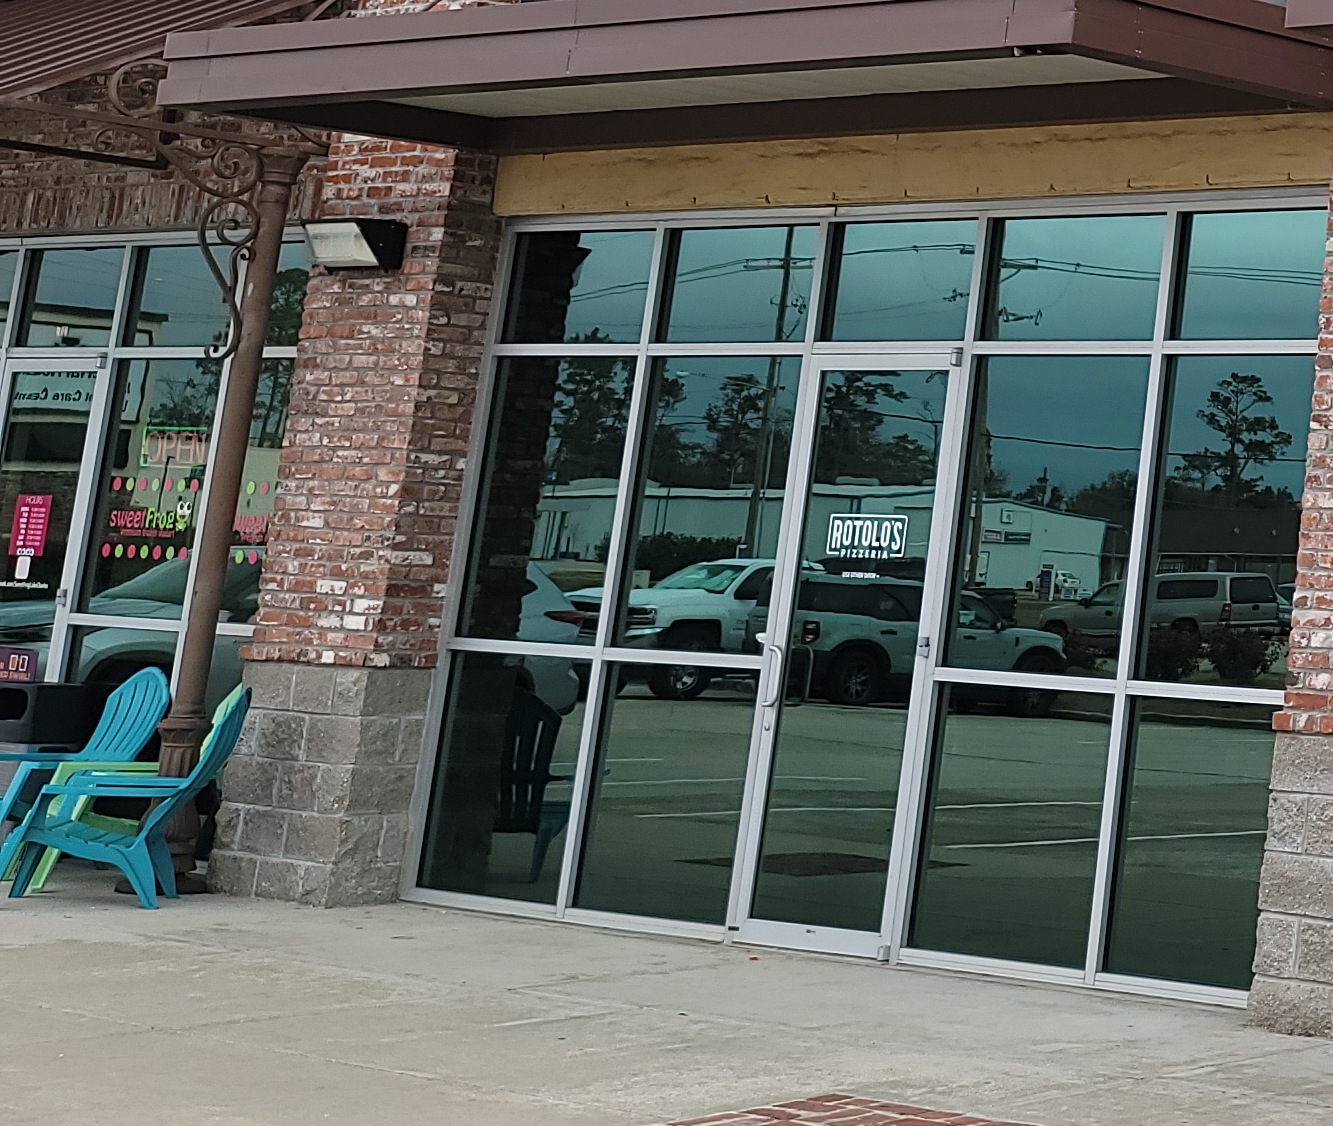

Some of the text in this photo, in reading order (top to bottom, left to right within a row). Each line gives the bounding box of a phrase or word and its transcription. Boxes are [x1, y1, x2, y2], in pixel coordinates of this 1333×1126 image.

[145, 430, 207, 464] OPEN
[25, 495, 44, 505] HOURS
[109, 507, 176, 530] sweetFrog
[831, 519, 903, 551] ROTOLO'S
[840, 548, 889, 560] PIZZERIA
